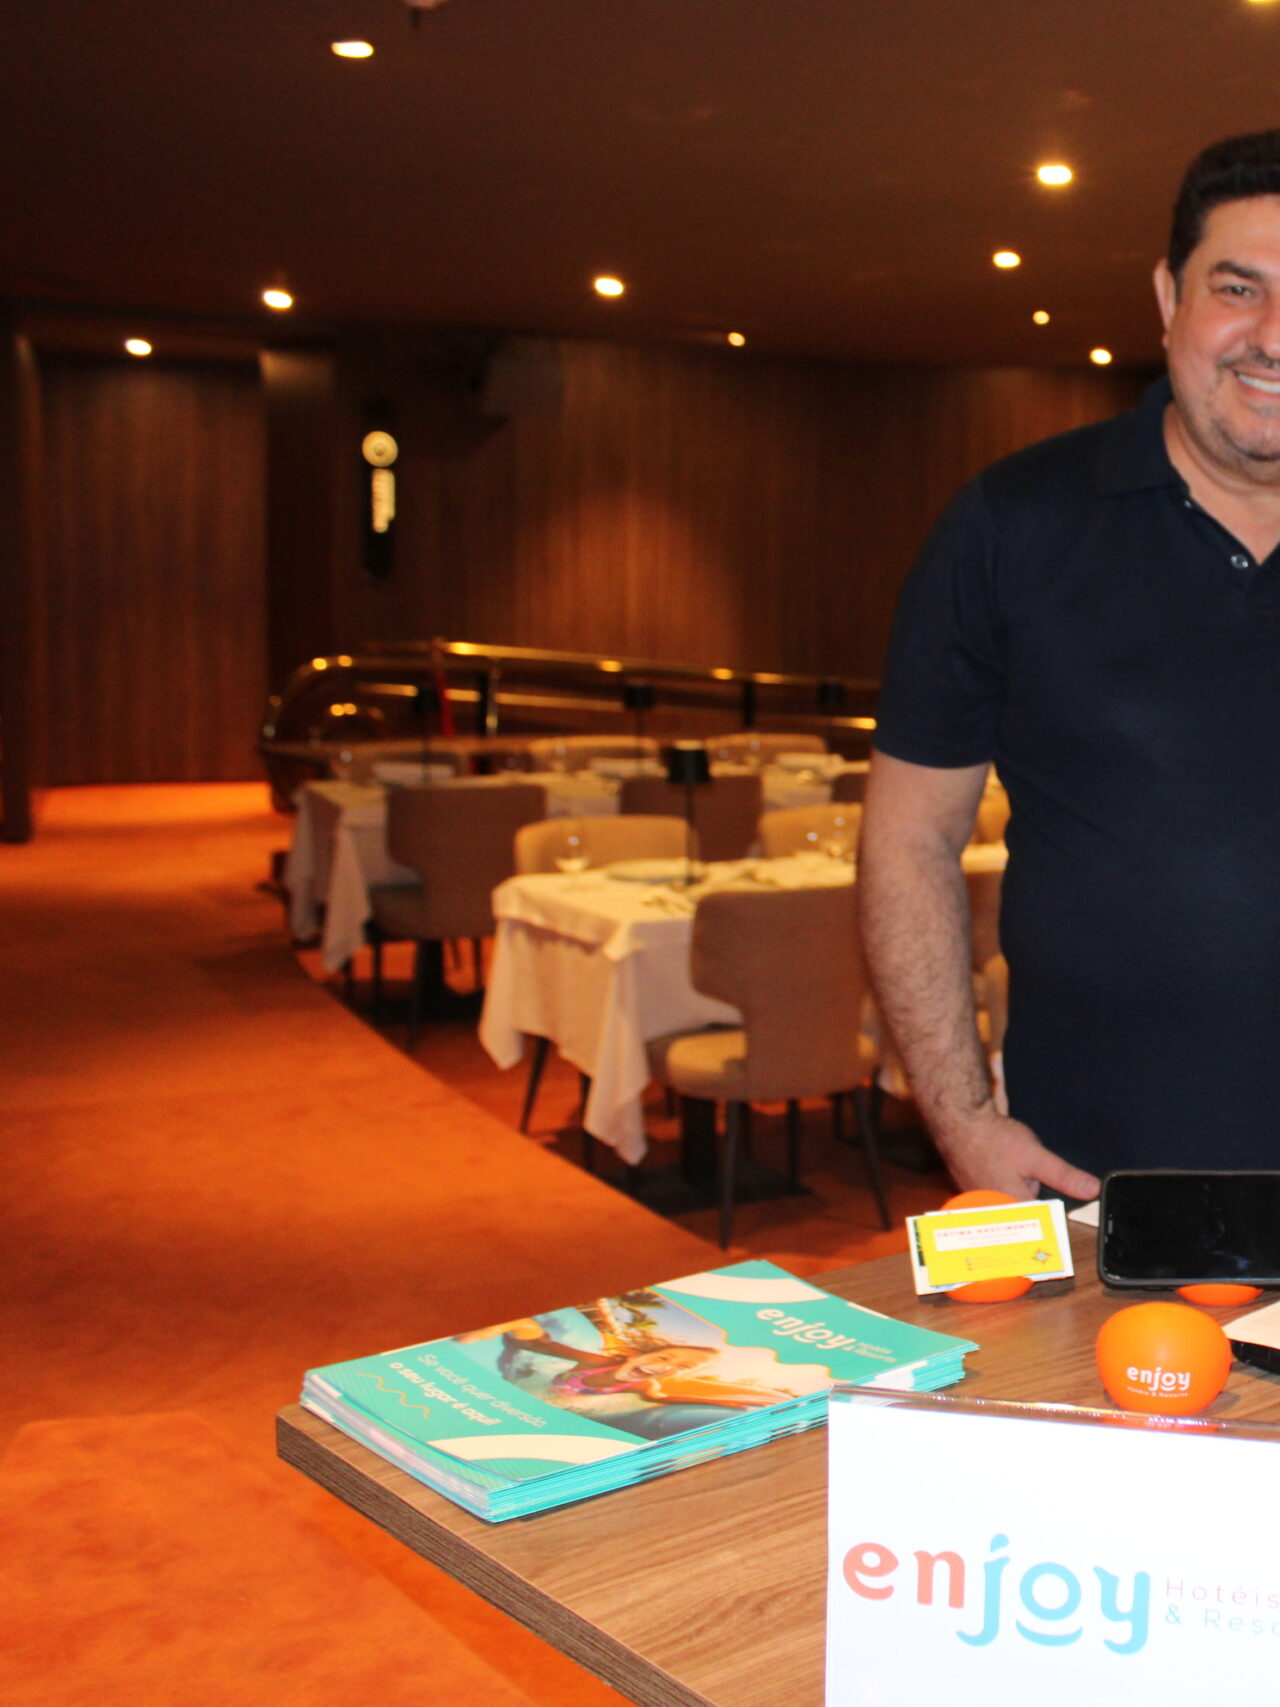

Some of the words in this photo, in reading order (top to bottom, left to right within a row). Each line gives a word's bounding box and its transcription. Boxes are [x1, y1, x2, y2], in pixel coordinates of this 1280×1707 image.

[755, 1308, 857, 1349] enjoy
[389, 1361, 404, 1370] o
[397, 1368, 427, 1385] seu
[420, 1381, 459, 1403] lugar
[417, 1353, 439, 1367] Se
[461, 1384, 497, 1401] quer
[1126, 1366, 1191, 1392] enjoy
[843, 1533, 1151, 1655] enjoy
[1166, 1577, 1280, 1610] Hotéis
[1164, 1603, 1182, 1626] &
